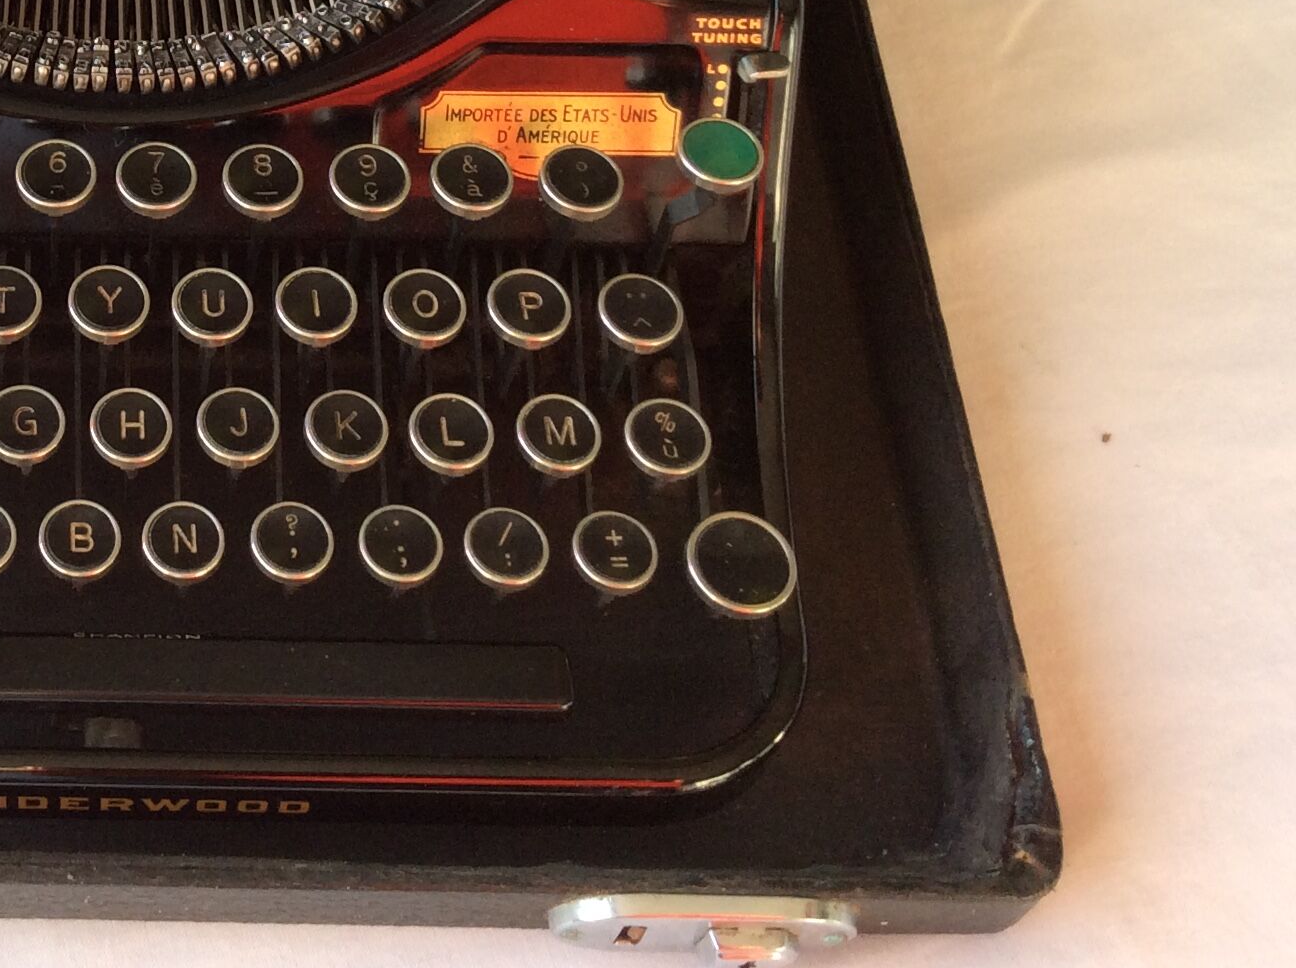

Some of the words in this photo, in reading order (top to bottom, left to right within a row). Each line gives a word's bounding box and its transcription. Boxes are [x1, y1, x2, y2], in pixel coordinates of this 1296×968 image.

[695, 17, 762, 30] TOUCH
[691, 32, 762, 45] TUNING
[529, 107, 558, 123] DES
[49, 150, 67, 173] 6
[147, 151, 165, 173] 7
[254, 153, 273, 176] 8
[358, 154, 377, 177] 9
[462, 154, 478, 174] &
[97, 285, 123, 314] Y
[202, 289, 226, 318] U
[311, 289, 321, 318] I
[412, 289, 439, 318] O
[518, 291, 544, 320] P
[13, 406, 39, 436] G
[120, 409, 146, 441] H
[229, 407, 249, 438] J
[334, 410, 362, 441] K
[439, 416, 465, 447] L
[542, 415, 578, 447] M
[70, 521, 95, 554] B
[171, 523, 198, 554] N
